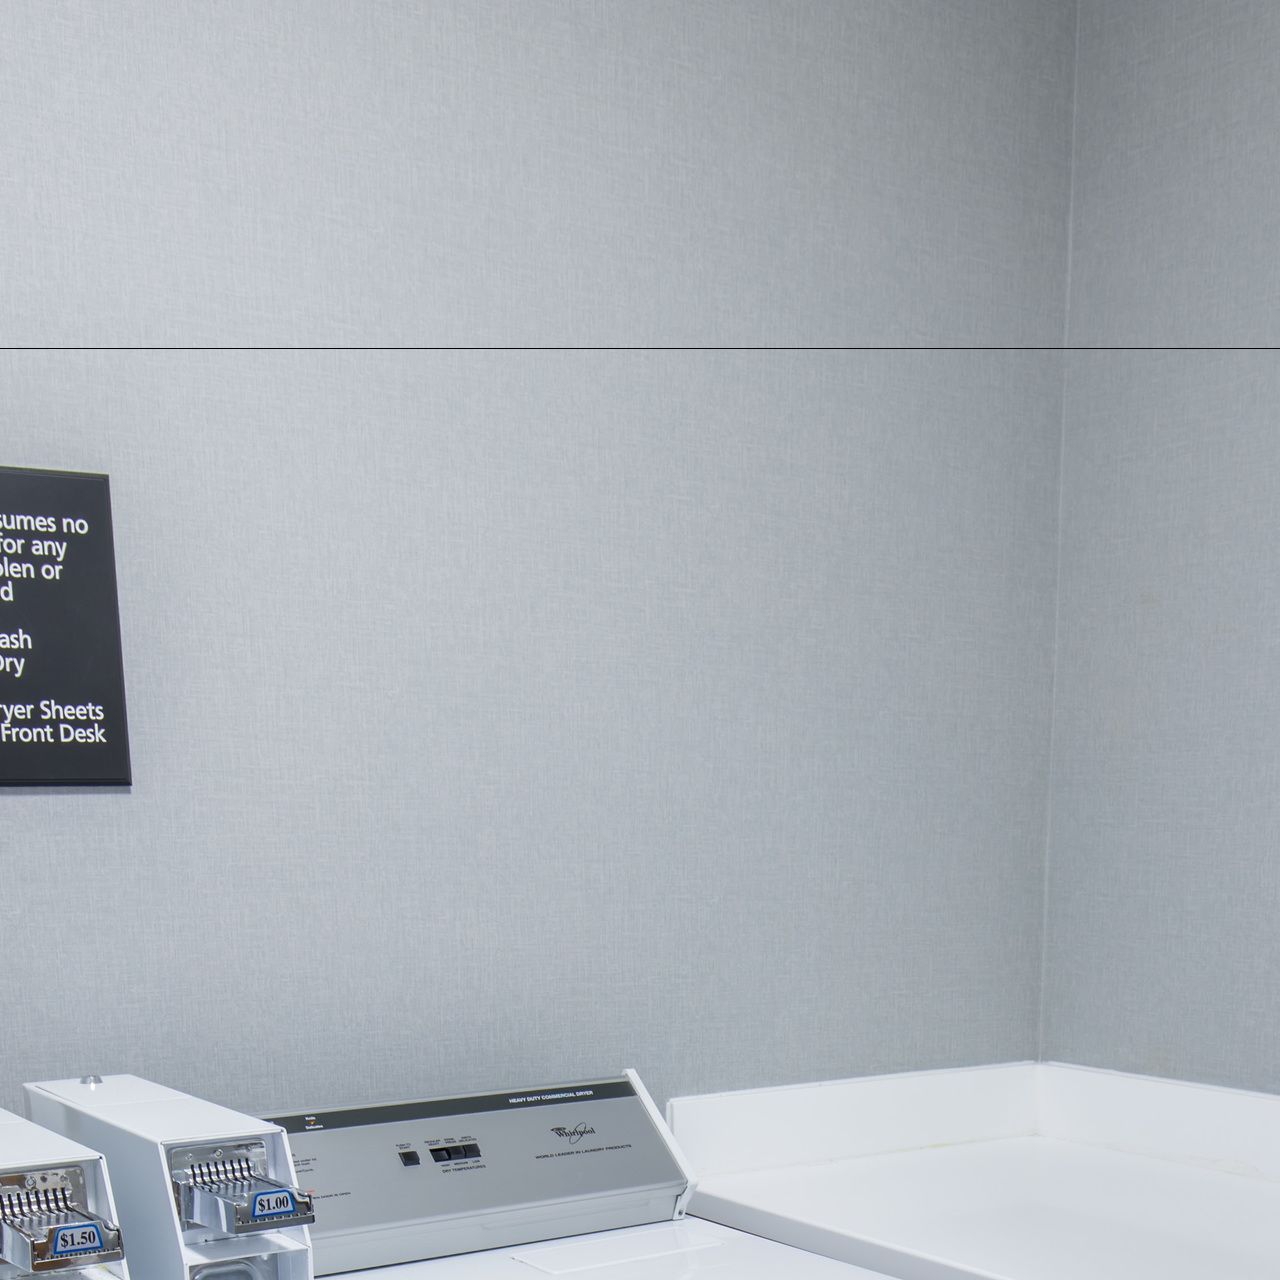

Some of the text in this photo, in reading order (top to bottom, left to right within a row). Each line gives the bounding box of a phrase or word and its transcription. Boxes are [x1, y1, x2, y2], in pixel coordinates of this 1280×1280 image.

[62, 514, 89, 535] no
[30, 537, 67, 562] any
[41, 562, 63, 580] or
[39, 699, 105, 721] Sheets
[0, 723, 55, 743] Front
[59, 723, 108, 744] Desk
[554, 1126, 596, 1139] Whirlpool
[257, 1195, 289, 1213] $1.00
[59, 1230, 96, 1249] $1.50
